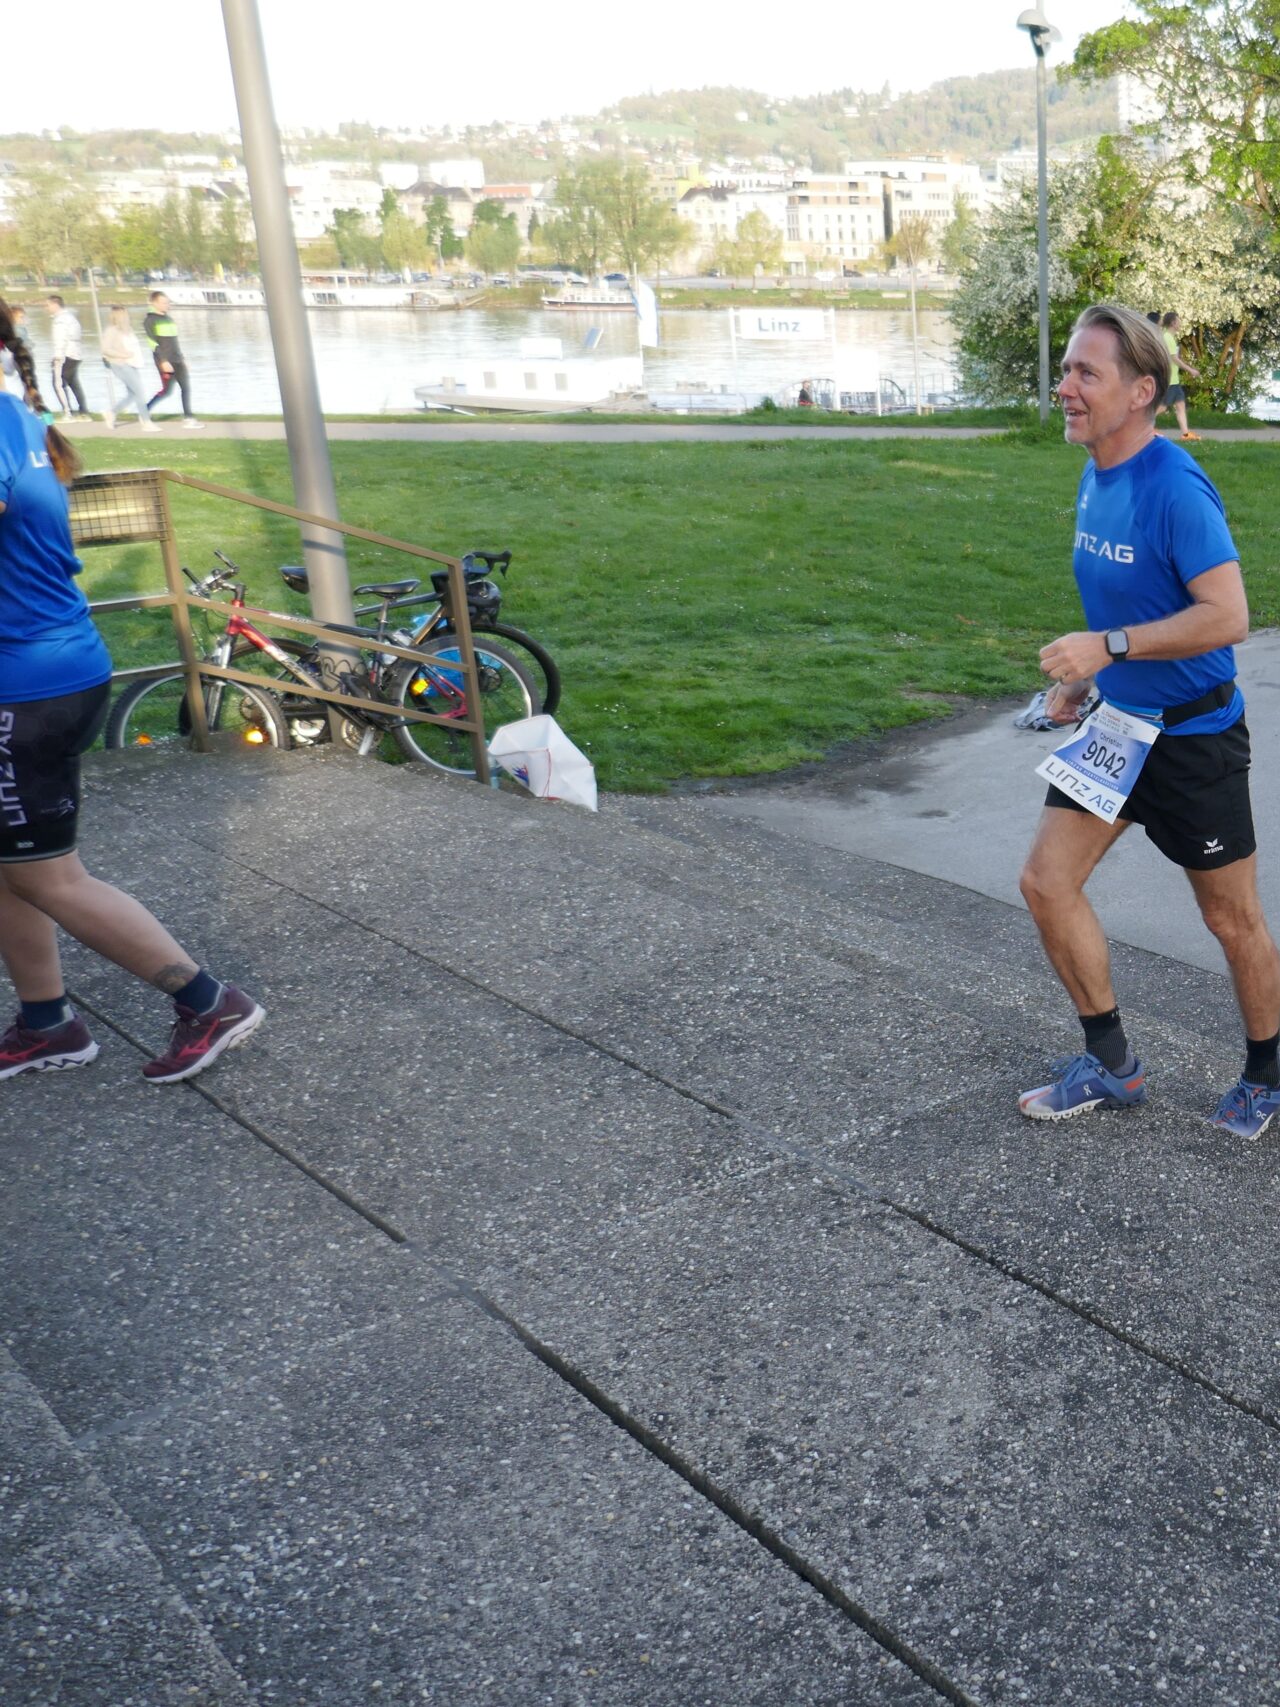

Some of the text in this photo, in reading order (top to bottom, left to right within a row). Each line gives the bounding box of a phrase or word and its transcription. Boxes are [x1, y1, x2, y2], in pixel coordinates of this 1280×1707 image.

[757, 317, 801, 333] Linz
[1098, 541, 1134, 564] AG
[1082, 740, 1127, 780] 9042
[1088, 794, 1116, 814] AG
